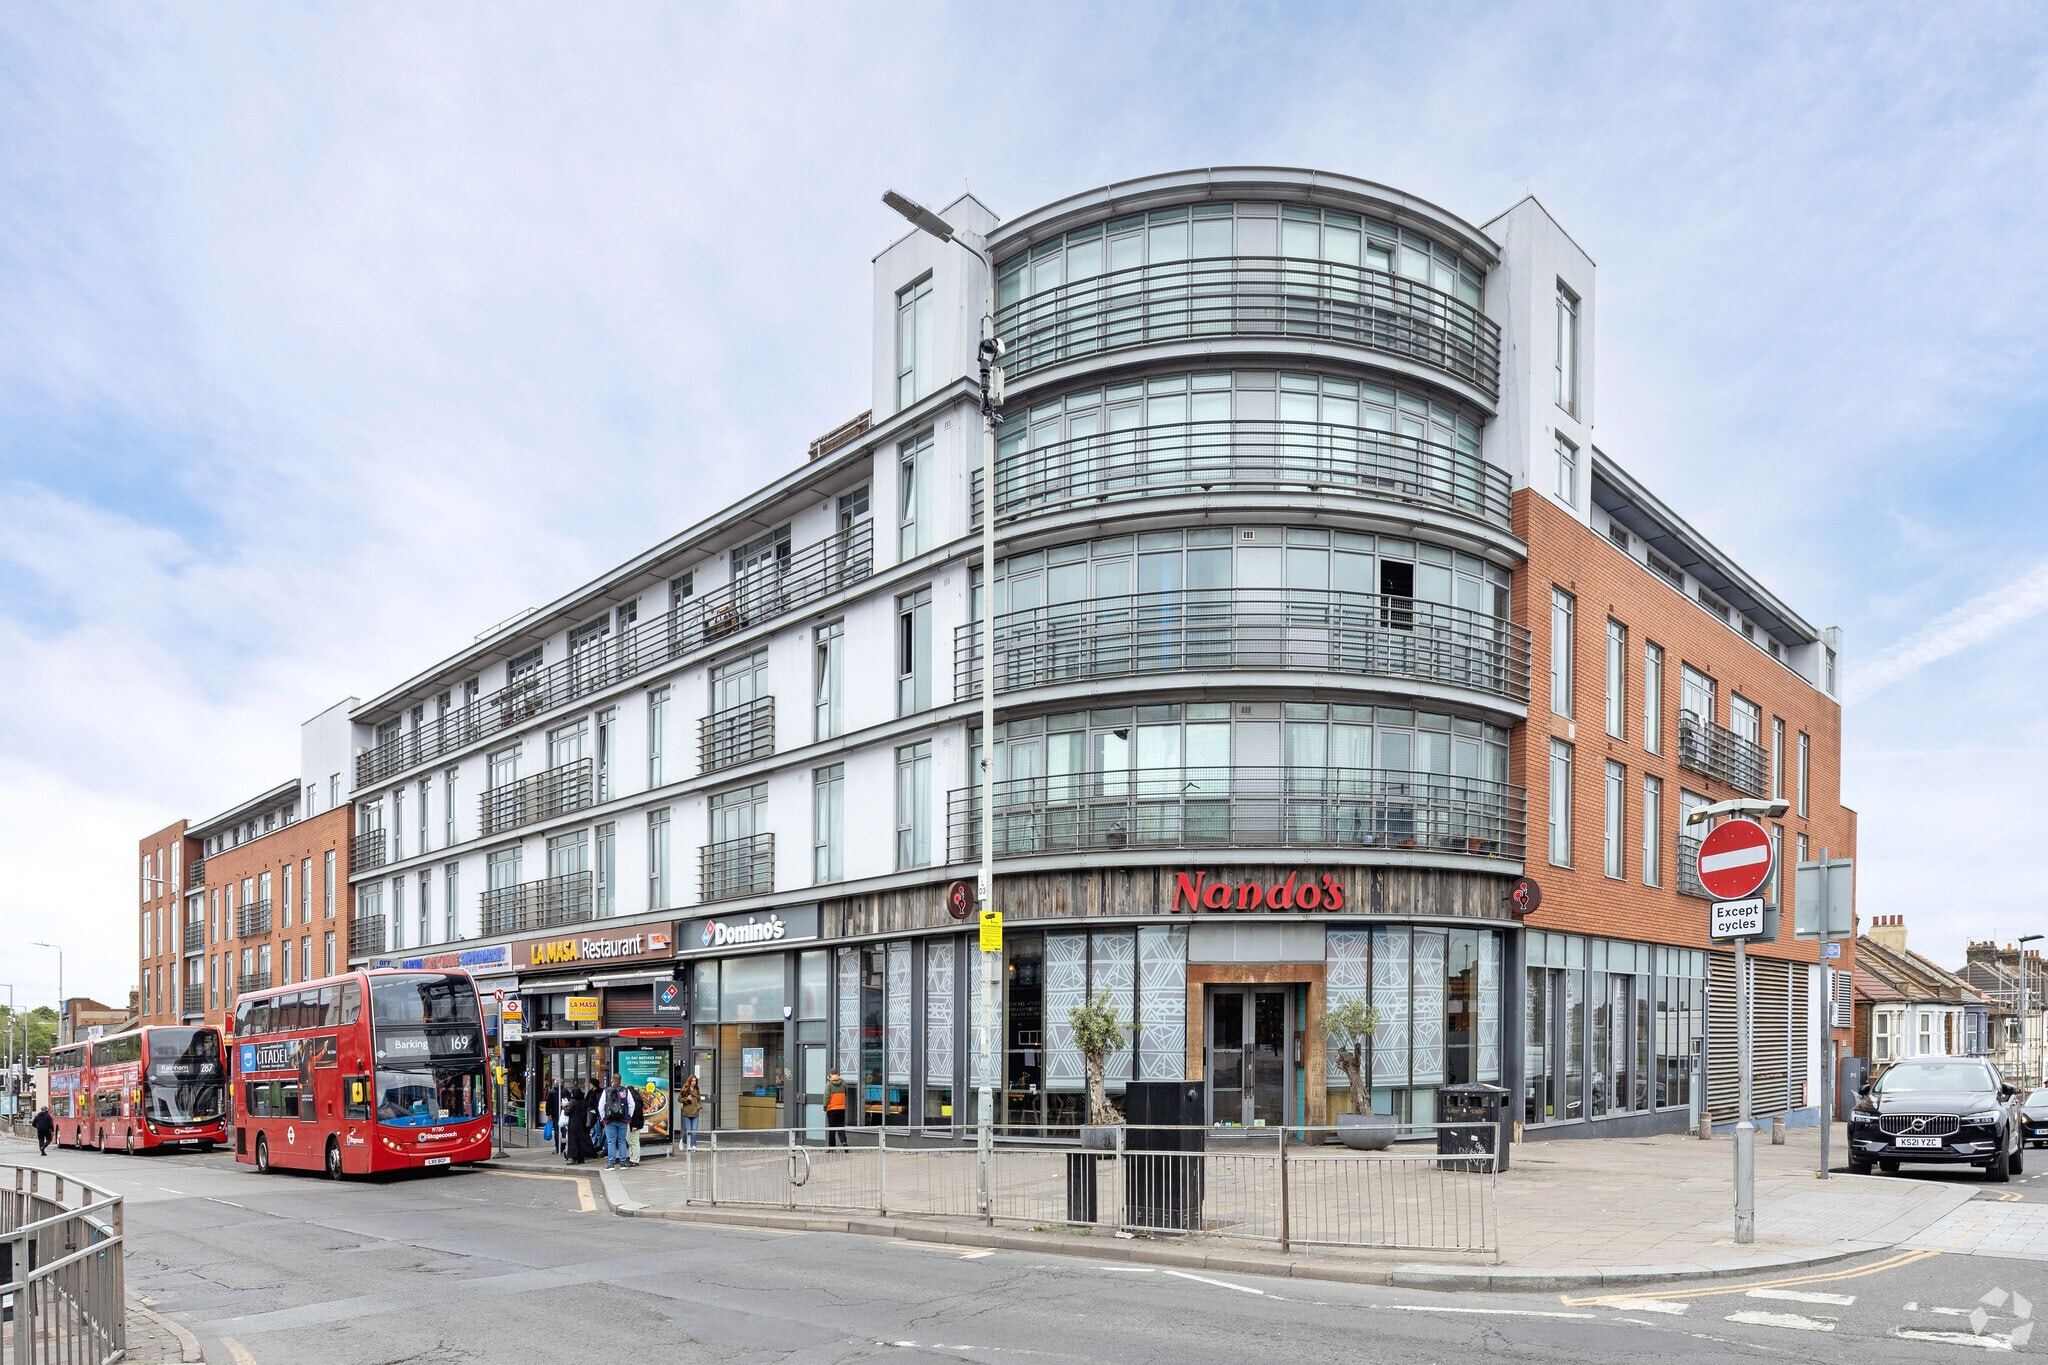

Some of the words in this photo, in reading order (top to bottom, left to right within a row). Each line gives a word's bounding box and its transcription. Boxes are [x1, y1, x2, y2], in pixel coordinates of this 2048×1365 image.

[1170, 870, 1345, 912] Nando's
[1717, 904, 1759, 918] Except
[715, 914, 785, 946] Domino's
[1718, 919, 1756, 932] cycles
[531, 944, 544, 965] LA
[546, 939, 578, 963] MASA
[582, 933, 642, 959] Restaurant
[395, 1040, 429, 1050] Barking
[451, 1036, 469, 1050] 169
[256, 1048, 290, 1065] CITADEL
[200, 1063, 213, 1073] 287
[426, 1131, 458, 1139] Stagecoach
[1900, 1138, 1919, 1147] KS21
[1921, 1138, 1937, 1147] YZC
